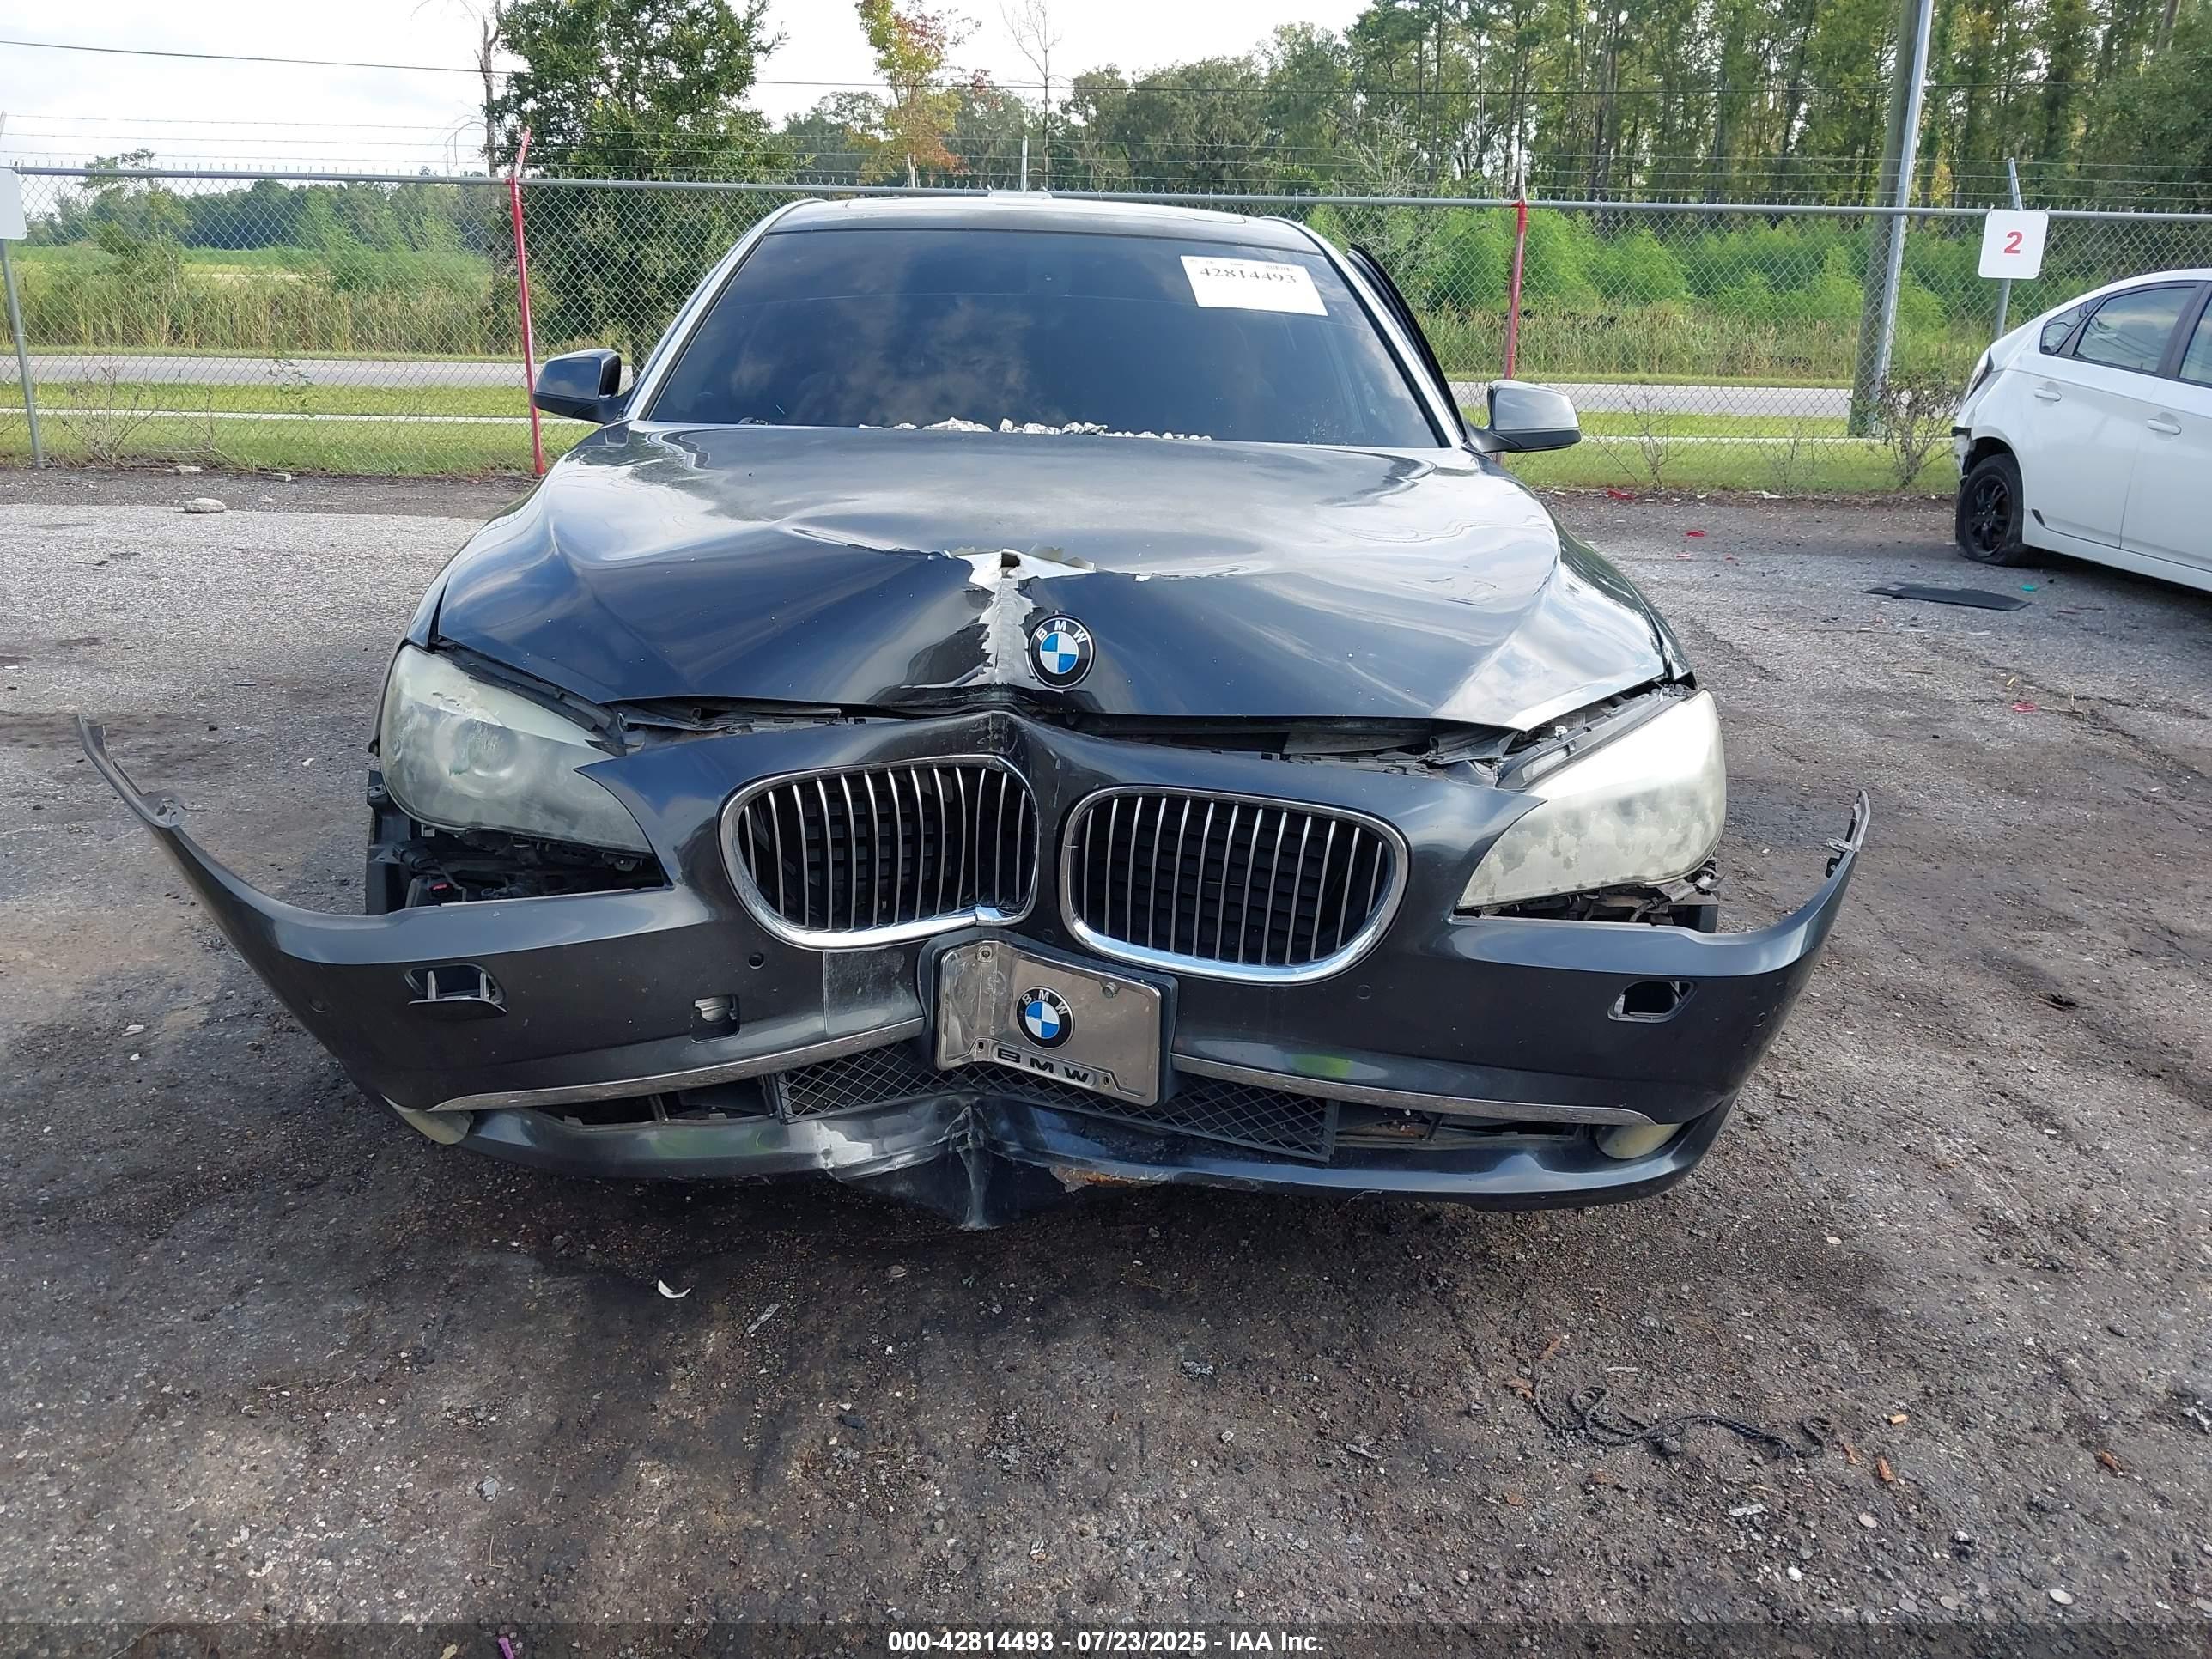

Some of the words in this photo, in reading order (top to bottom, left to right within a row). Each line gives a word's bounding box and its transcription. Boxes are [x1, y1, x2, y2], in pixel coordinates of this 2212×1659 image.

[2003, 230, 2023, 255] 2
[1200, 267, 1297, 284] 42814493
[1036, 620, 1088, 644] BMW
[1021, 988, 1069, 1016] BMW
[997, 1048, 1090, 1084] BMW
